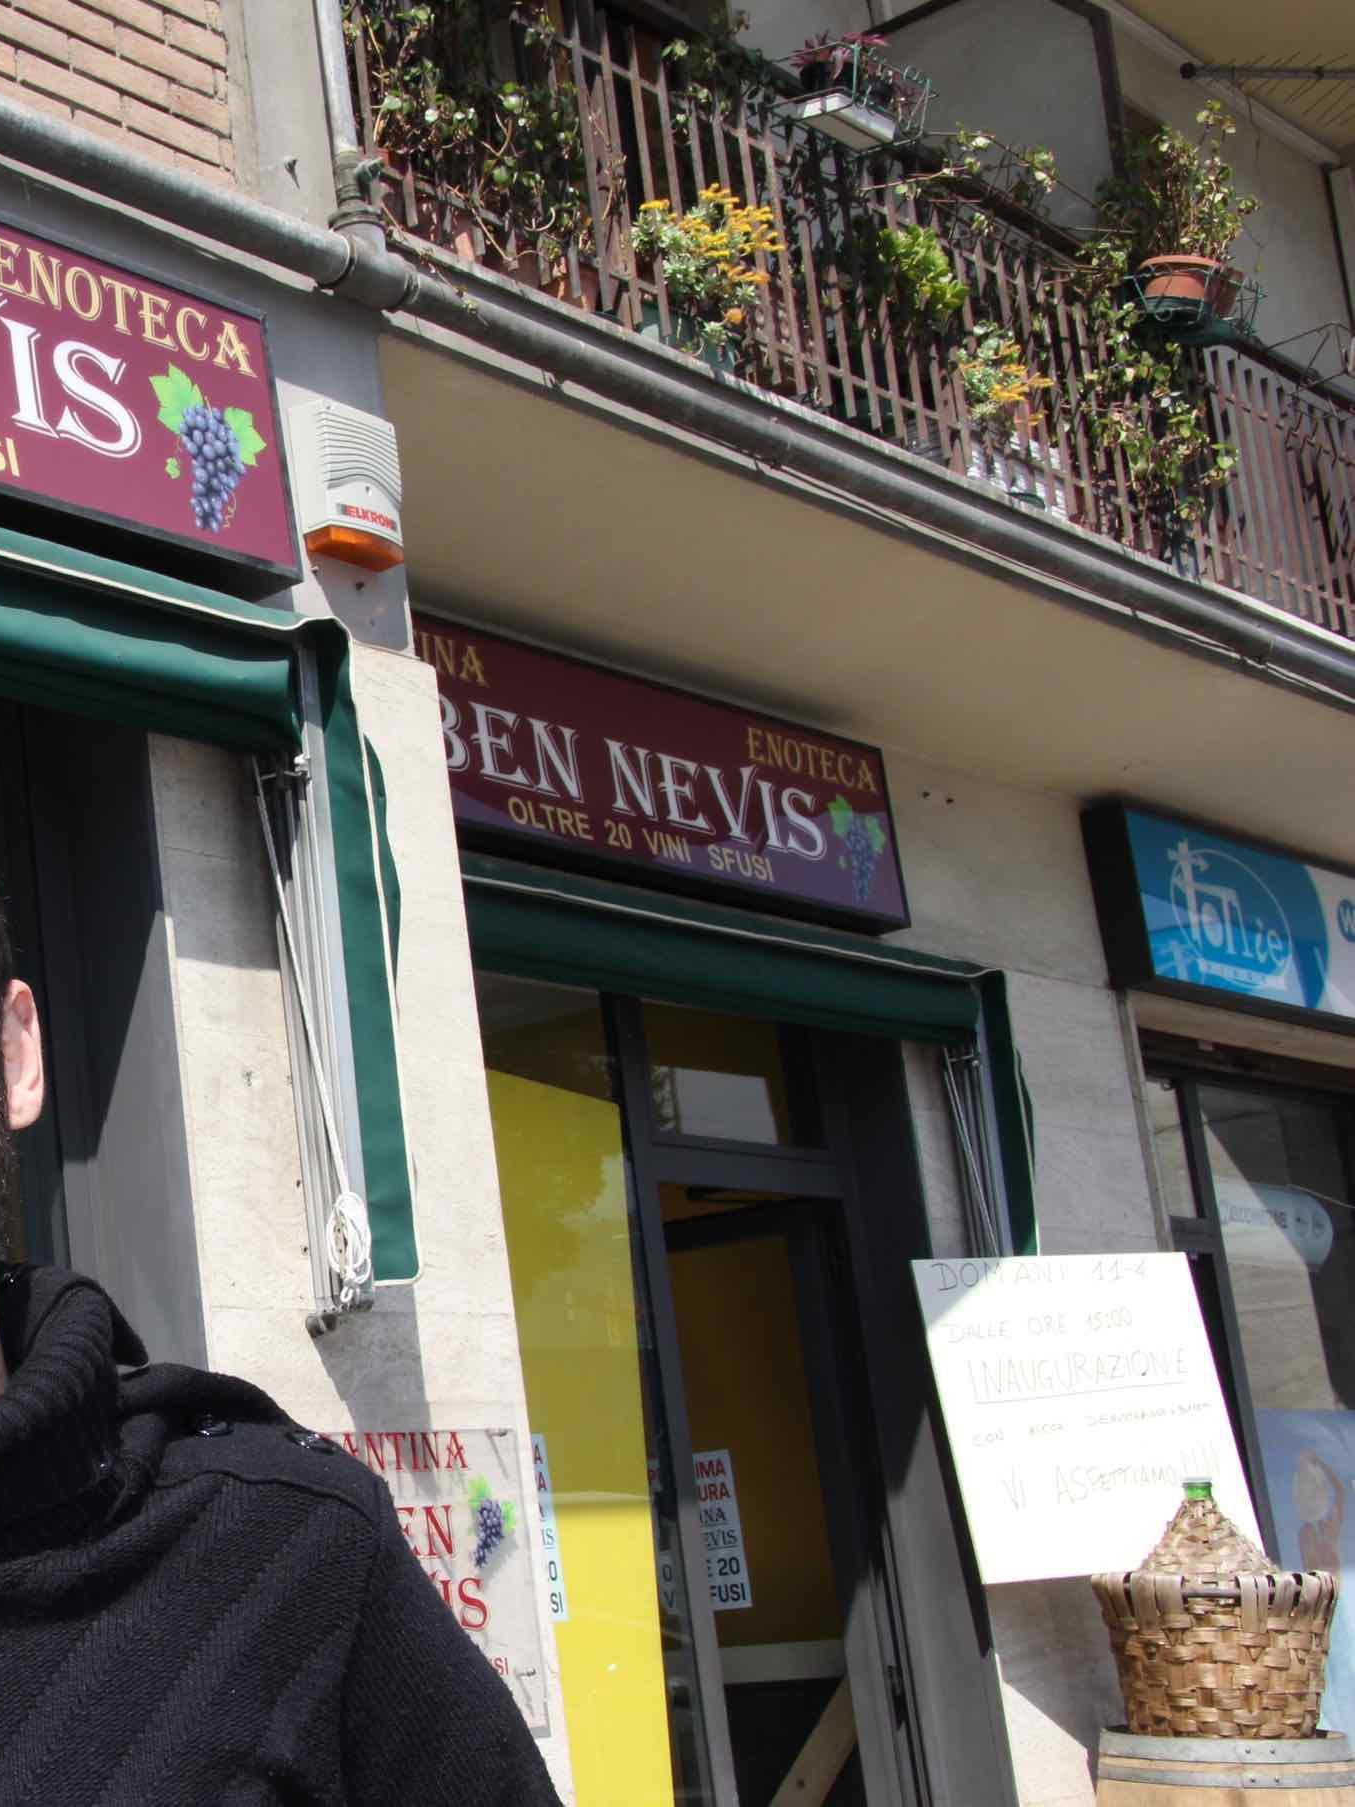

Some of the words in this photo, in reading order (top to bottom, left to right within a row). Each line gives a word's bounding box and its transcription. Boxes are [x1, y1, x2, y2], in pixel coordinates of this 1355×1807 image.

[416, 631, 490, 688] INA
[439, 692, 585, 804] BEN
[604, 737, 827, 861] NEVIS
[746, 726, 878, 796] ENOTECA
[508, 796, 594, 841] OLTRE
[604, 819, 632, 849] 20
[644, 829, 691, 864] VINI
[708, 846, 774, 883] SFUSI
